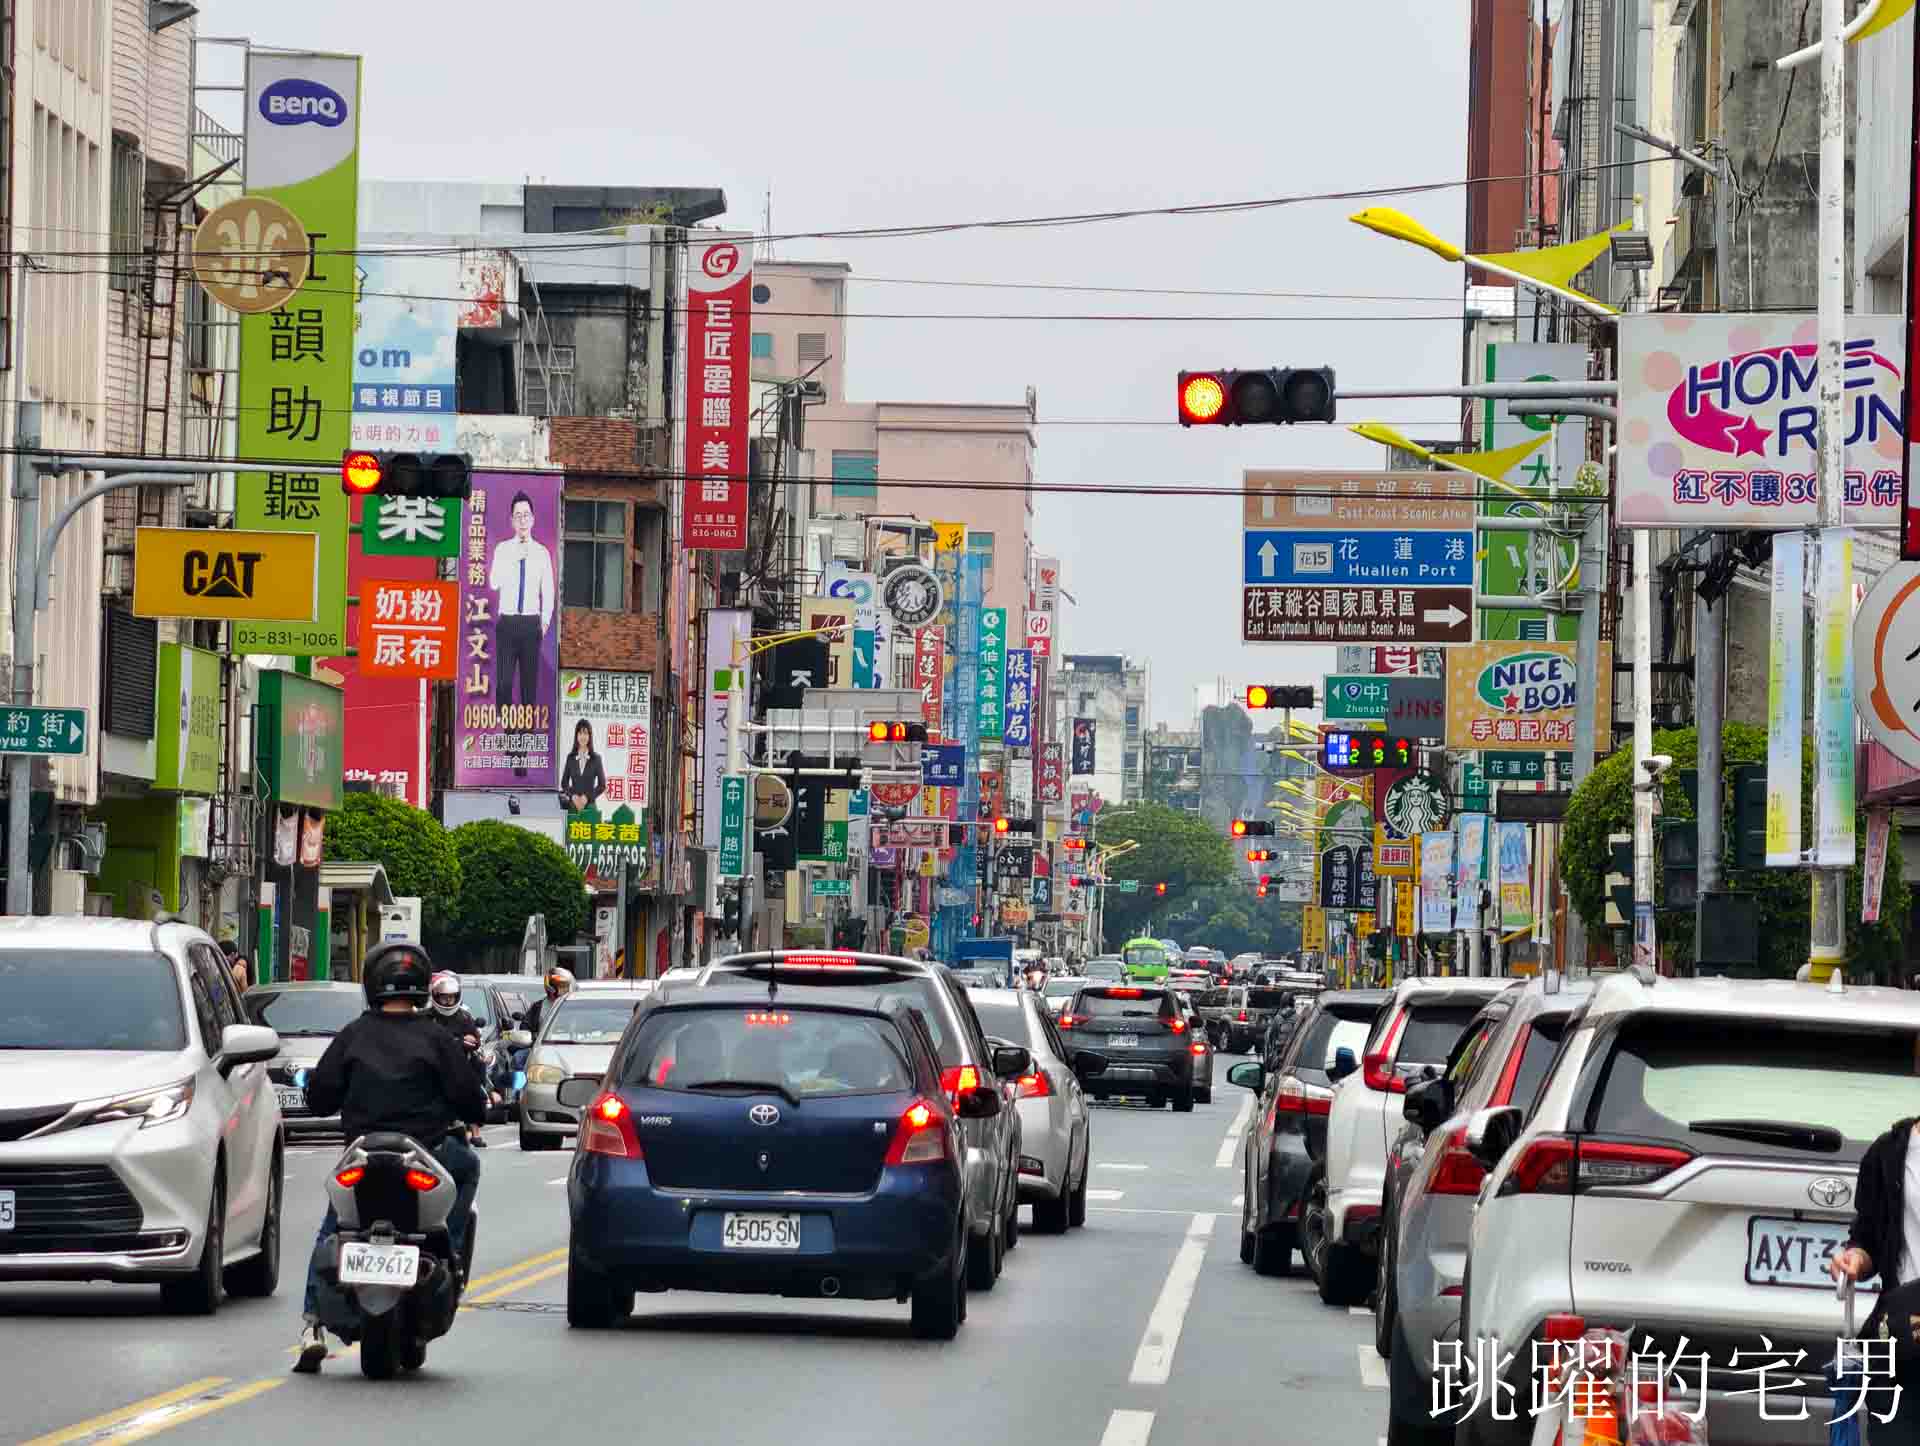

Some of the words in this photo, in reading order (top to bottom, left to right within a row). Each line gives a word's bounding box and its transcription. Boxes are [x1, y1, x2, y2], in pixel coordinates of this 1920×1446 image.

[269, 94, 338, 119] BenQ
[352, 387, 442, 408] 電視節目
[466, 489, 487, 587] 精品業務
[1338, 536, 1466, 561] 花蓮港
[183, 550, 261, 598] CAT
[1349, 563, 1409, 577] Hualien
[1419, 563, 1457, 577] Port
[375, 586, 443, 622] 奶粉
[1247, 588, 1416, 618] 花東縱谷國家風景區
[238, 631, 338, 647] 03-831-1006
[1247, 620, 1265, 635] East
[1314, 620, 1335, 639] Valley
[1338, 620, 1368, 635] National
[1371, 620, 1395, 635] Scenic
[1398, 621, 1416, 635] Area
[373, 633, 443, 669] 尿布
[464, 593, 493, 696] 江文山
[1494, 657, 1562, 689] NICE
[1005, 652, 1030, 742] 張藥局
[37, 735, 57, 748] St.
[1491, 760, 1573, 776] 花蓮中店
[724, 787, 741, 852] 中山路
[1583, 1259, 1632, 1273] TOYOTA
